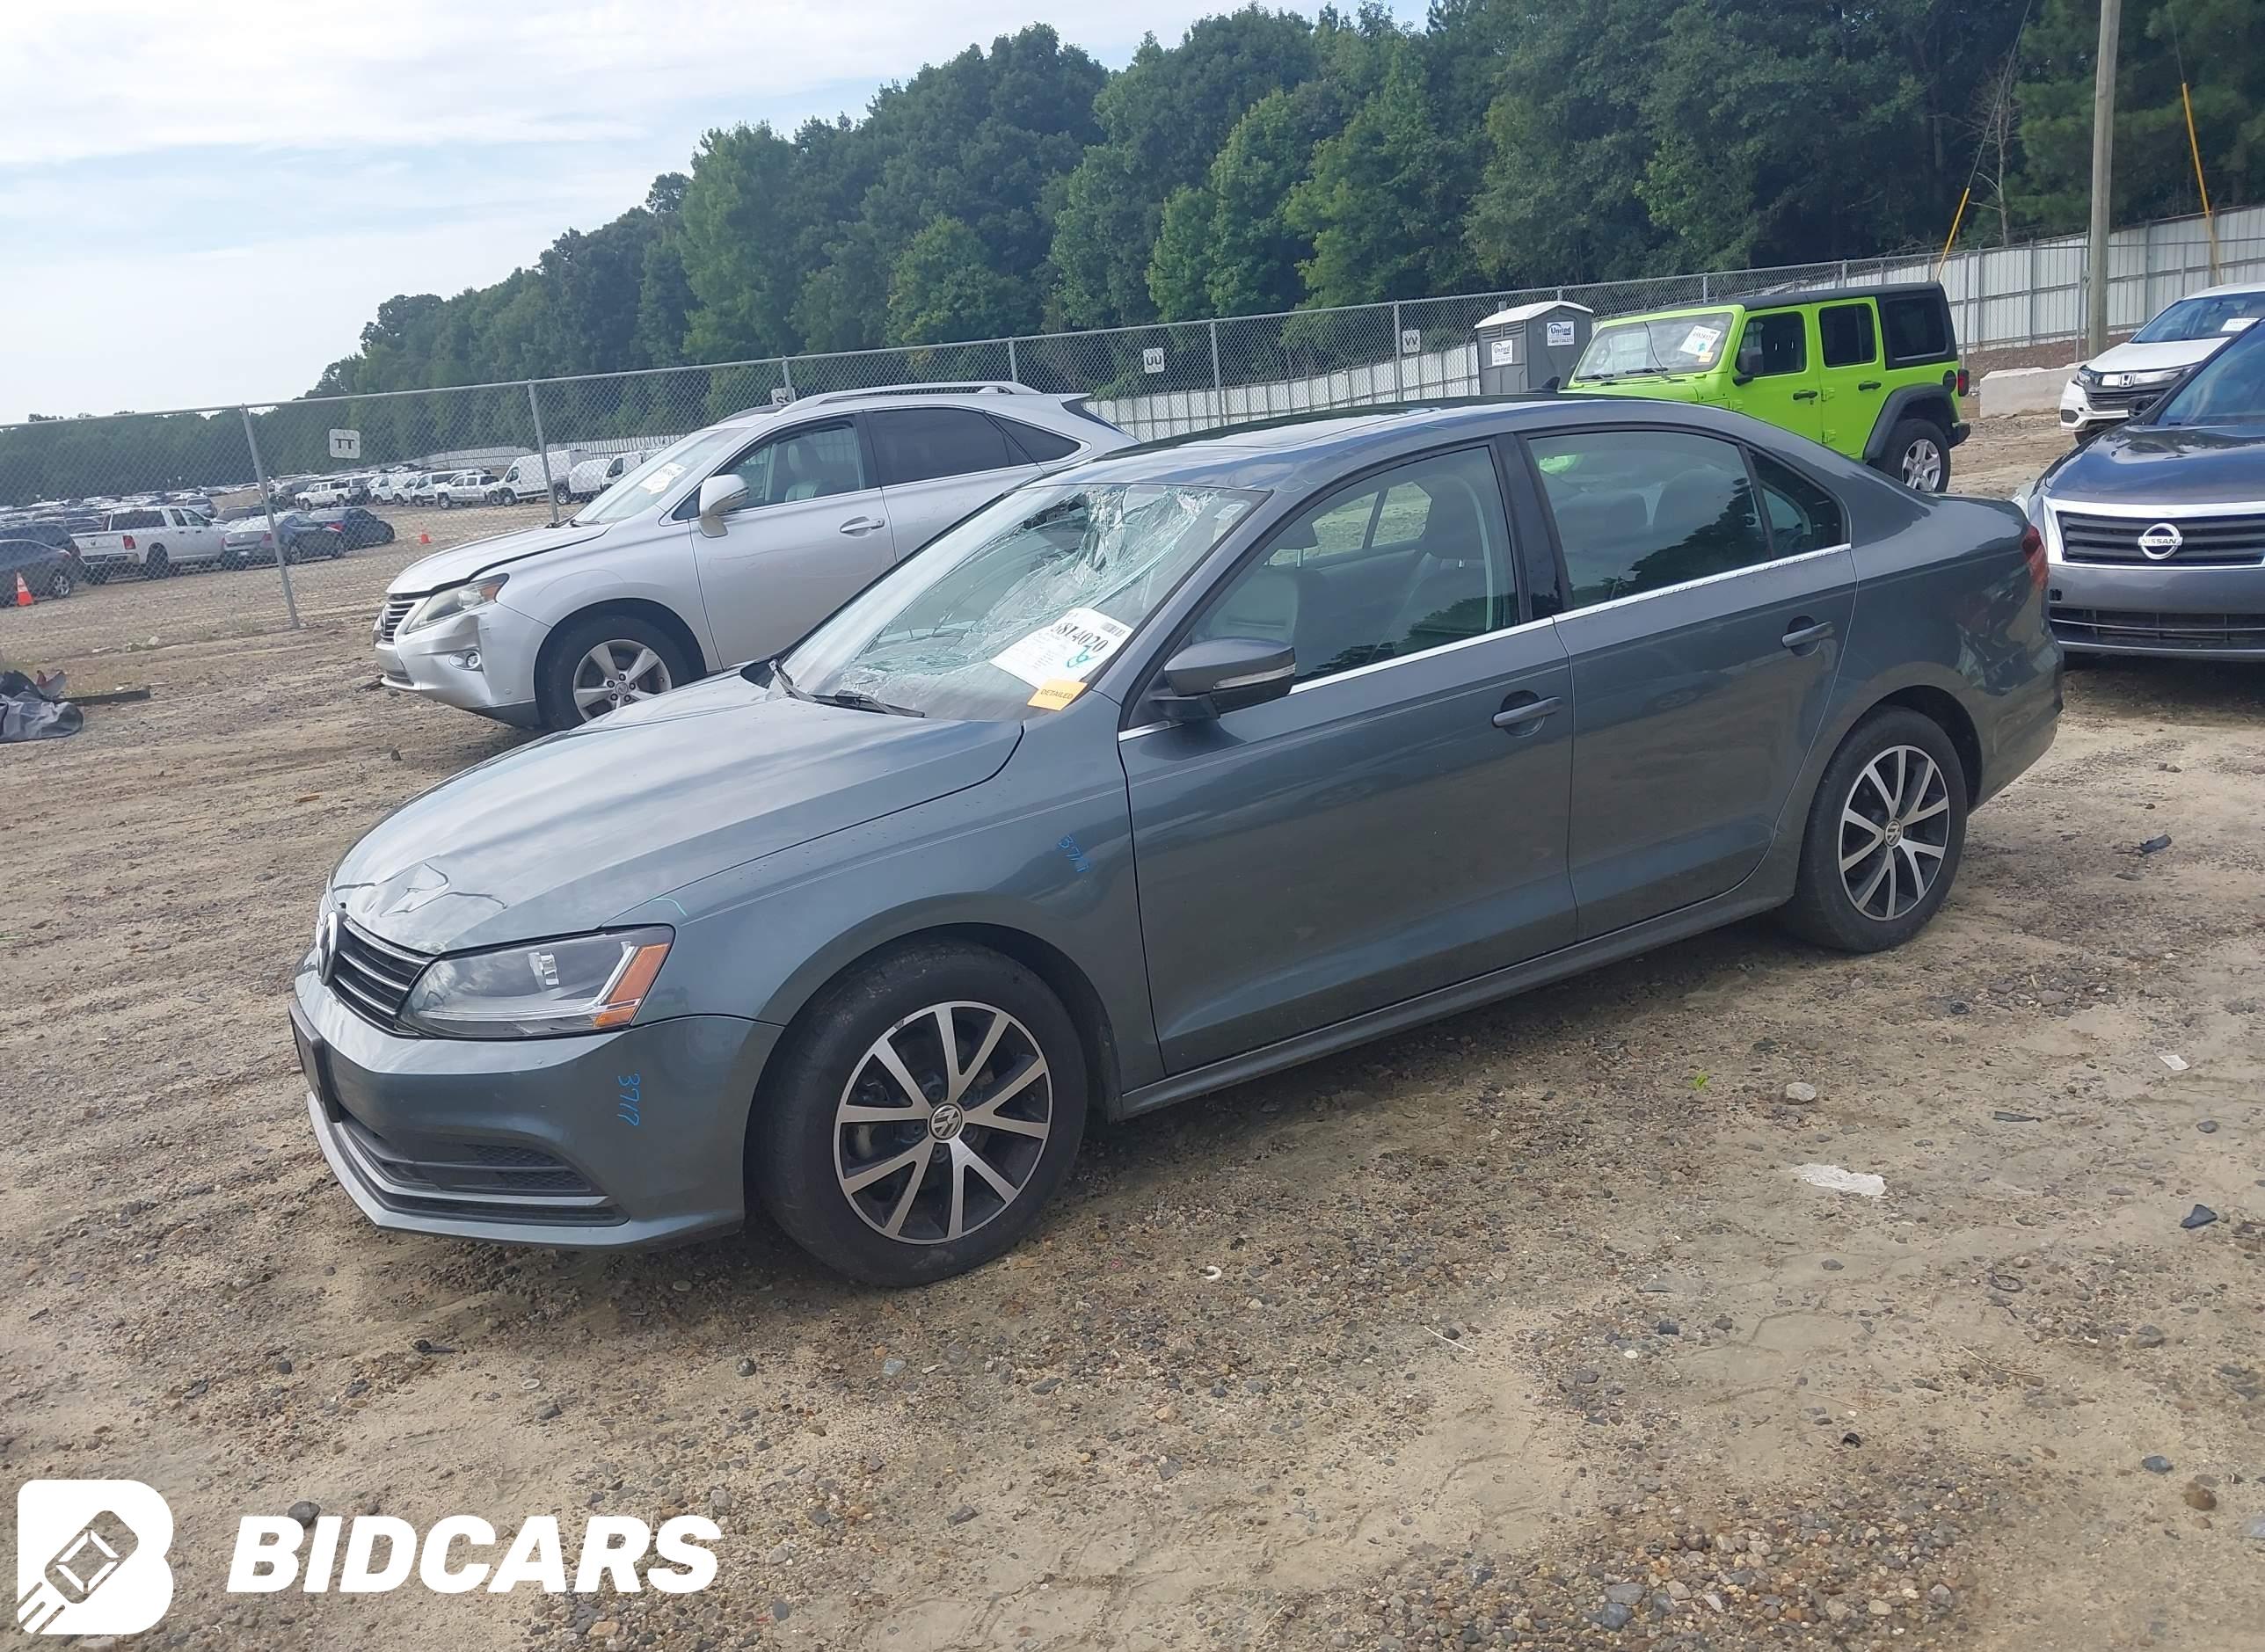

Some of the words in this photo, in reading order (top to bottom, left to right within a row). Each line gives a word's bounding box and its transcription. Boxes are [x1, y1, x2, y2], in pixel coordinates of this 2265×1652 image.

[1146, 355, 1162, 366] UU
[334, 438, 354, 449] TT
[1040, 688, 1074, 700] DETAILED
